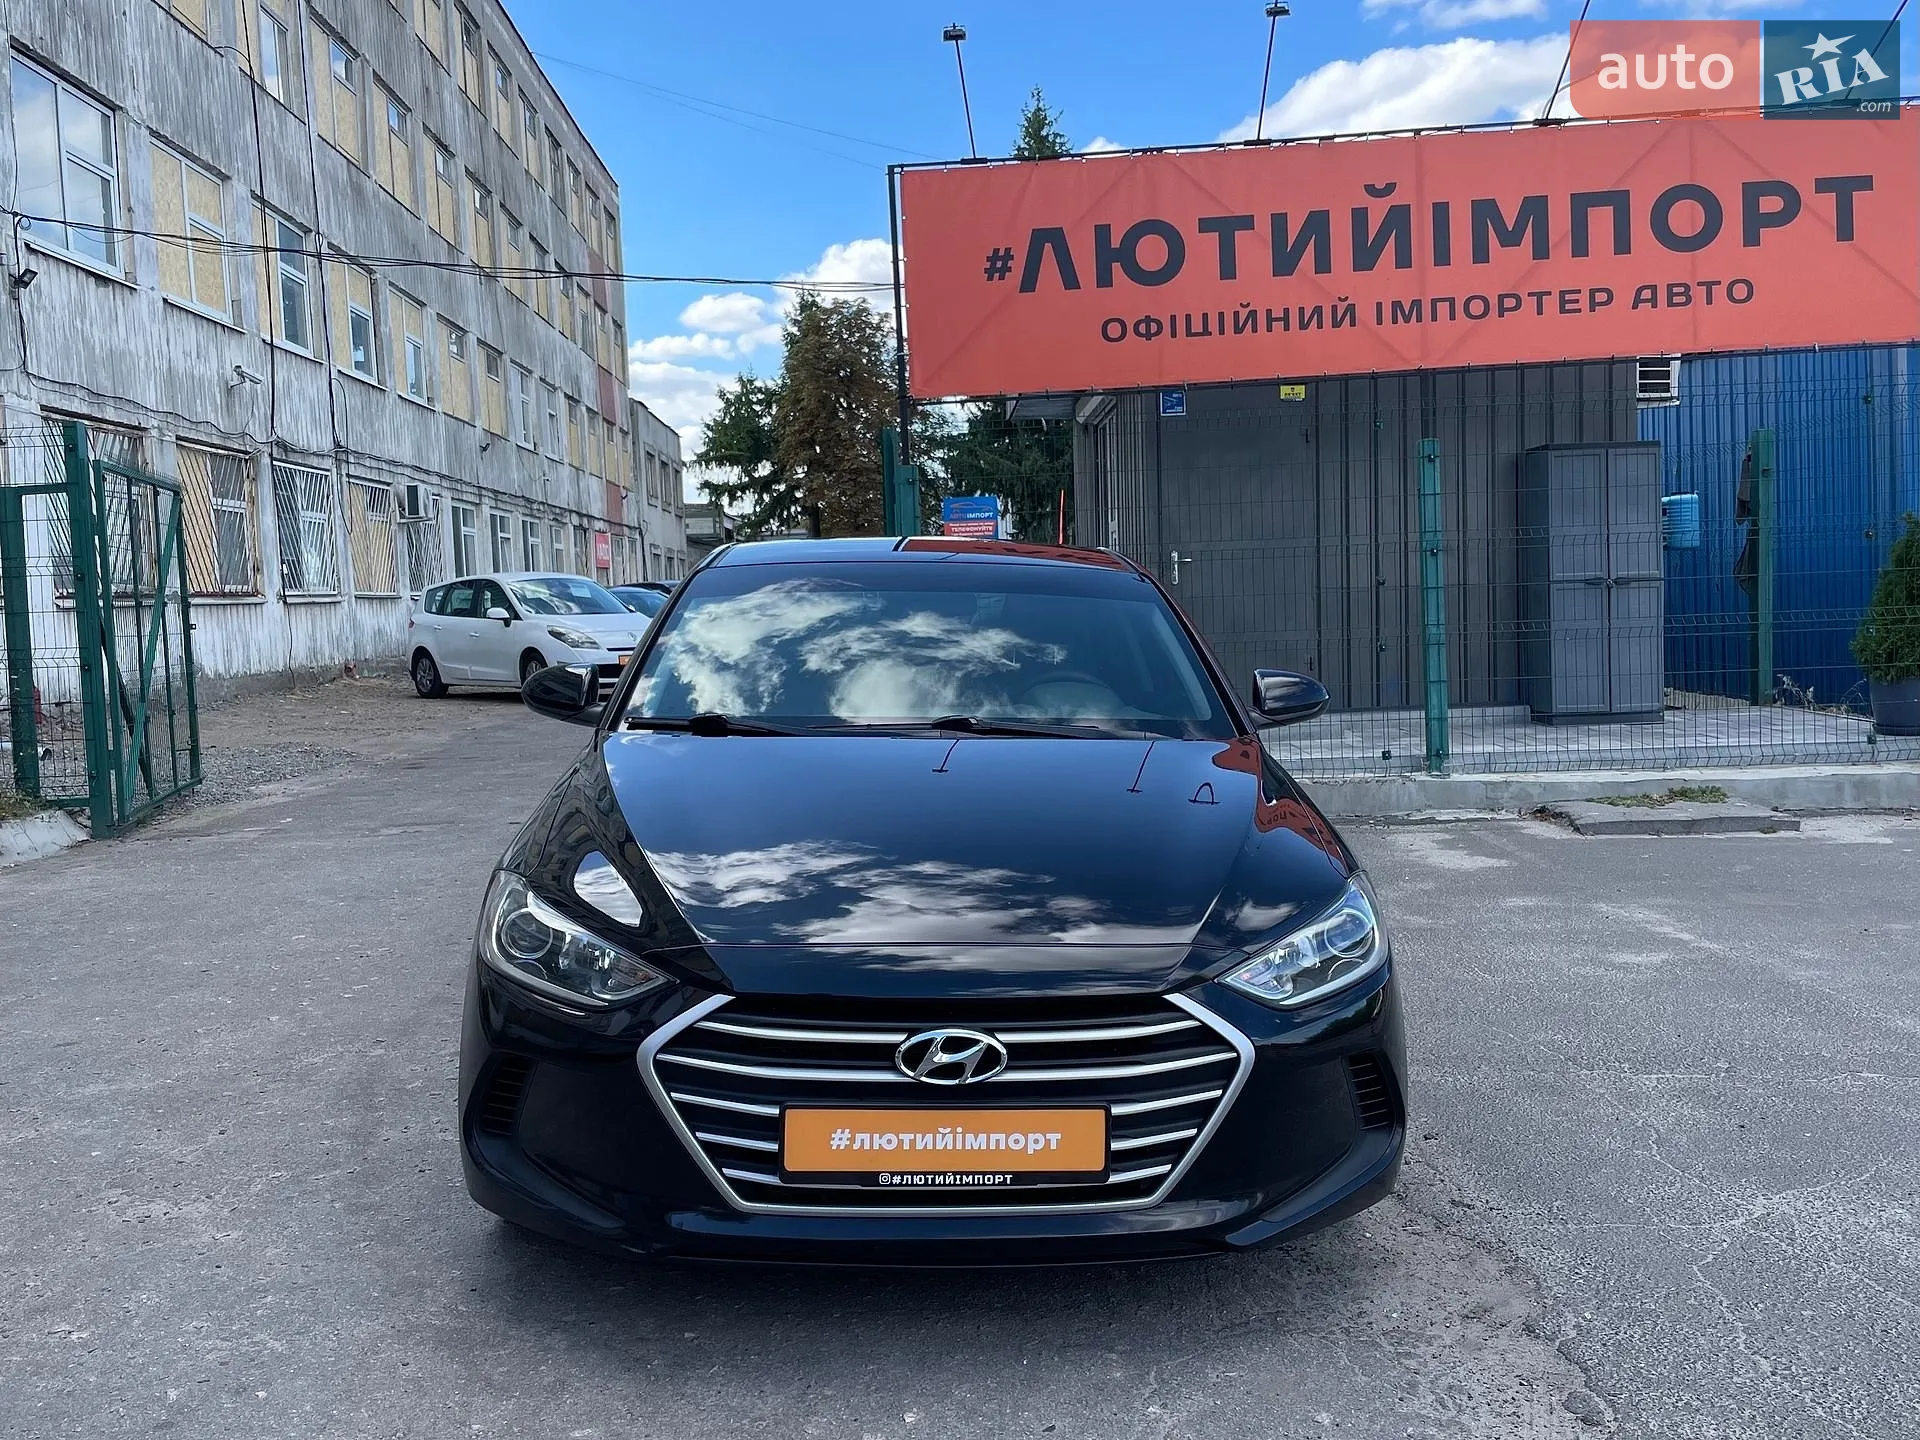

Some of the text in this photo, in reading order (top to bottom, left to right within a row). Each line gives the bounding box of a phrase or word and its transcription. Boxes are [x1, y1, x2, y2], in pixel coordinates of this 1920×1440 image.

[983, 175, 1874, 293] #ЛЮТИЙІМПОРТ
[1100, 278, 1754, 343] ОФІЦІЙНИЙ ІМПОРТЕР АВТО
[830, 1127, 1062, 1154] #лютийімпорт
[892, 1173, 1013, 1185] #ЛЮТИЙІМПОРТ
